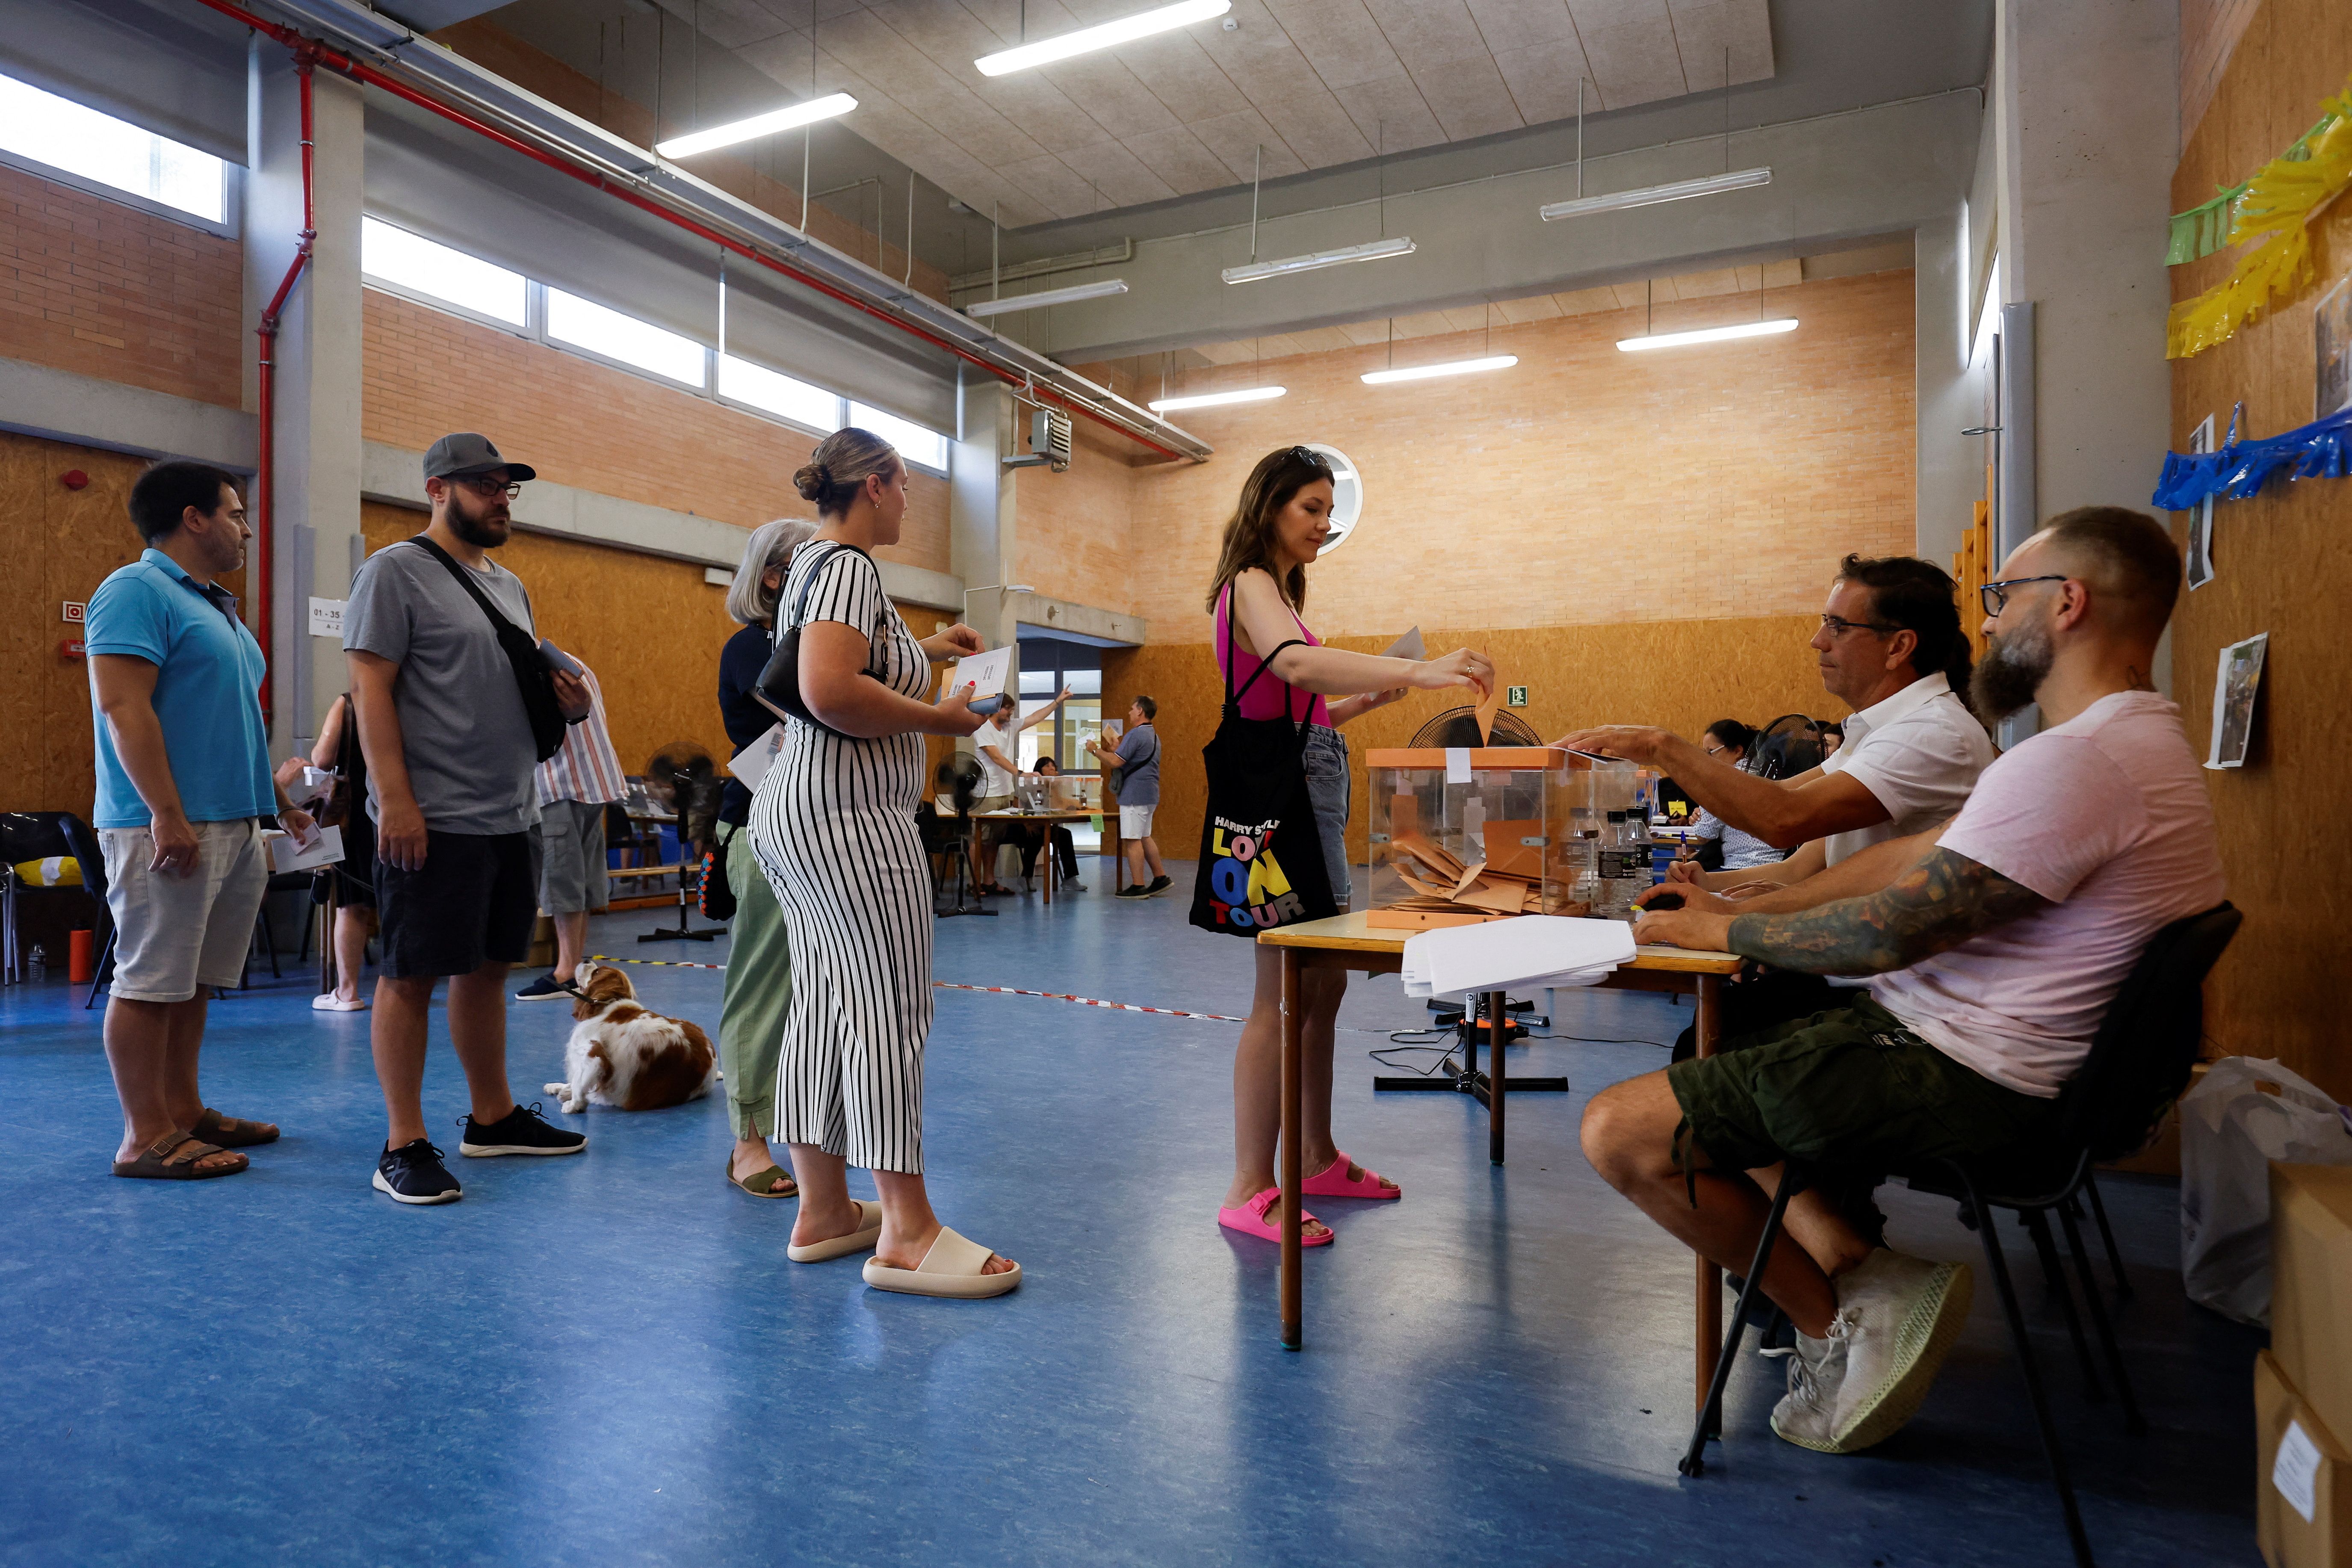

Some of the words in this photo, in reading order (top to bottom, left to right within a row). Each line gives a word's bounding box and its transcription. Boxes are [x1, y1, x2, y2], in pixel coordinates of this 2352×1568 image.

[1214, 816, 1253, 835] HARRY
[1212, 848, 1291, 907] ON
[1209, 892, 1306, 927] TOUR
